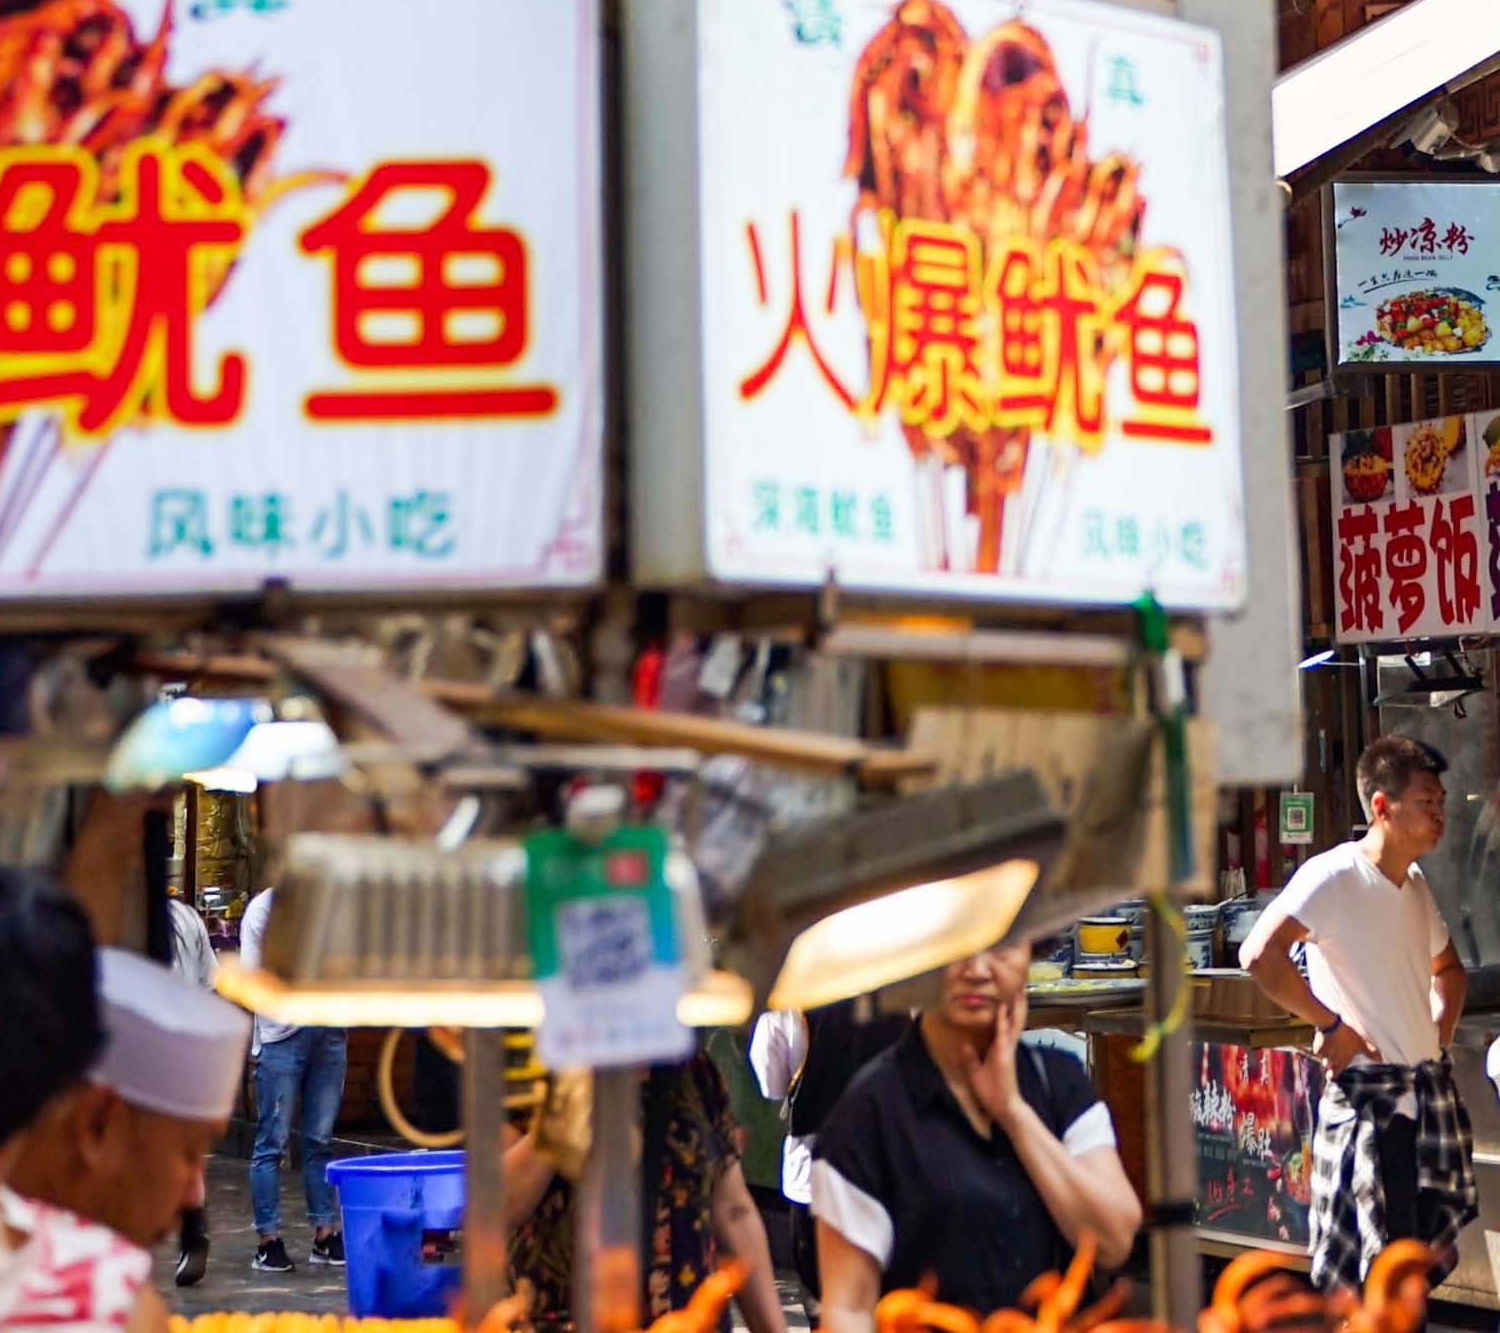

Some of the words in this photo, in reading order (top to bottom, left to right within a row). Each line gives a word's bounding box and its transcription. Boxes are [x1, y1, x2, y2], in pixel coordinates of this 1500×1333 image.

[1379, 216, 1476, 258] 炒凉粉
[737, 207, 1214, 454] 火爆鱿鱼
[146, 487, 458, 563] 风味小吃
[1338, 493, 1481, 635] 菠萝饭
